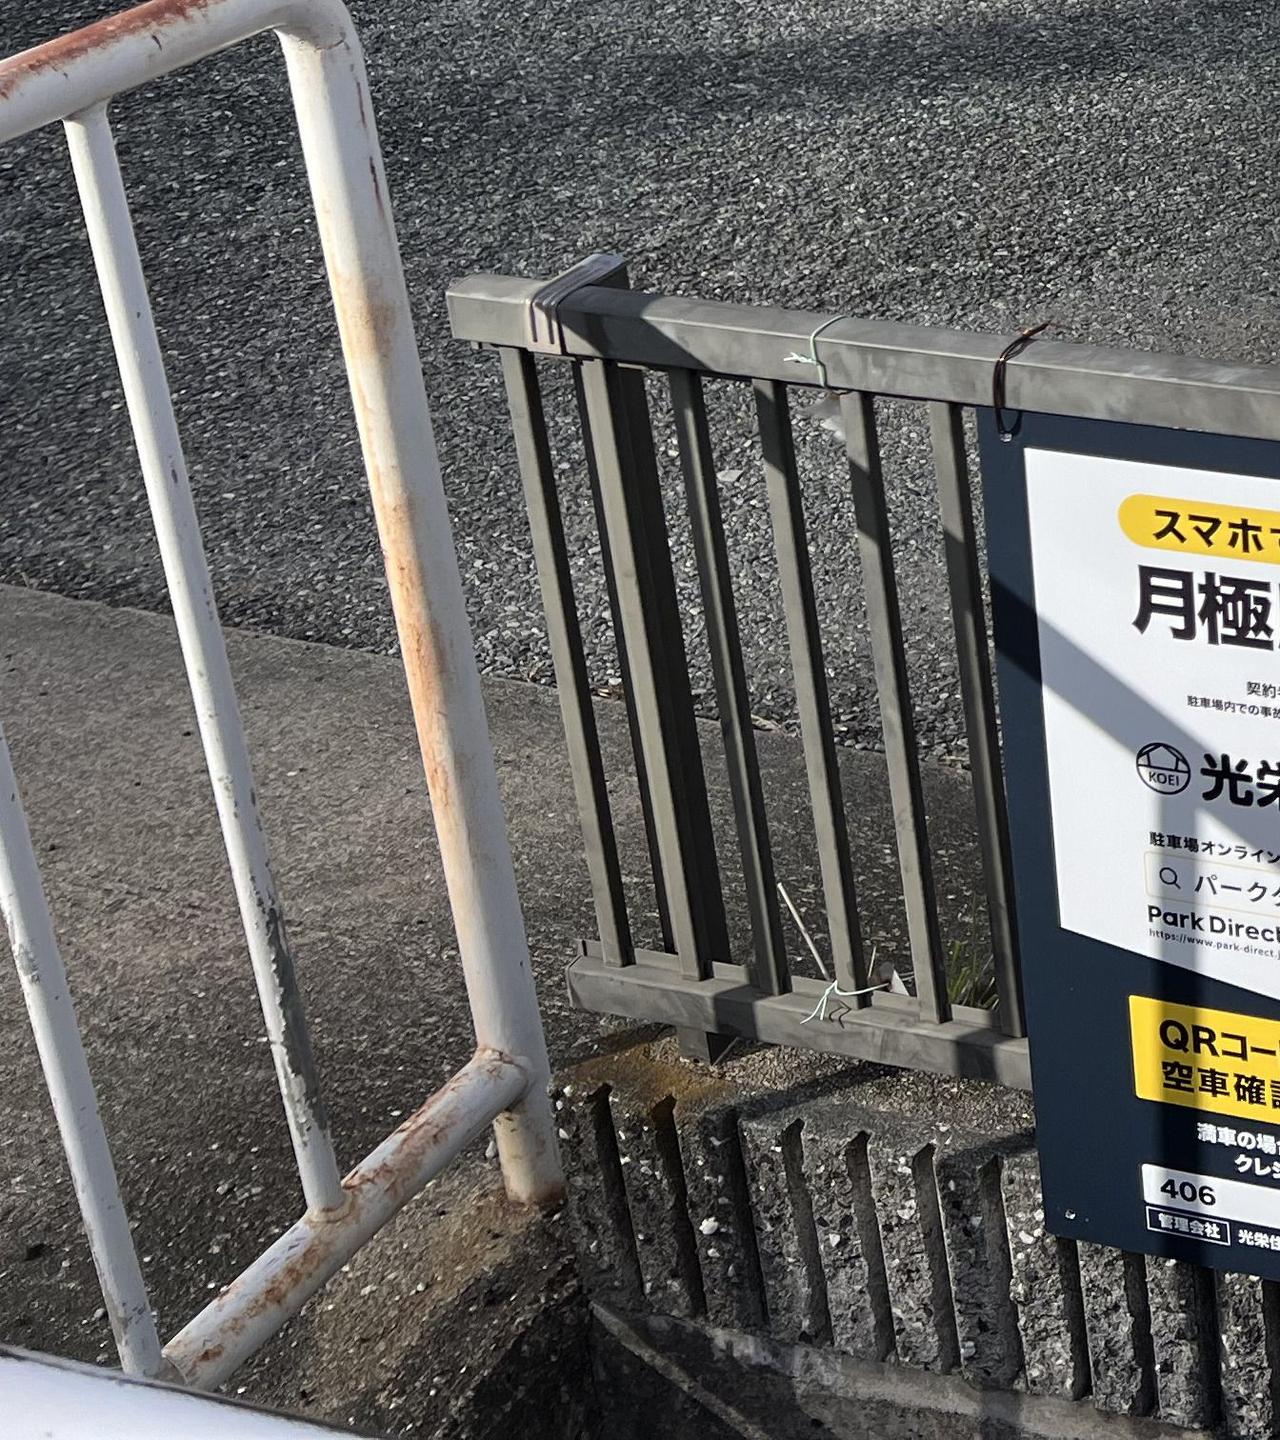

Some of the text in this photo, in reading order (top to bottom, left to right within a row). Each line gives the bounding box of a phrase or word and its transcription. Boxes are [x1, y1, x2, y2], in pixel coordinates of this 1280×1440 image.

[1148, 771, 1180, 787] KOEI
[1147, 905, 1204, 931] Park
[1160, 1178, 1217, 1207] 406
[1158, 1213, 1222, 1240] 管理会社
